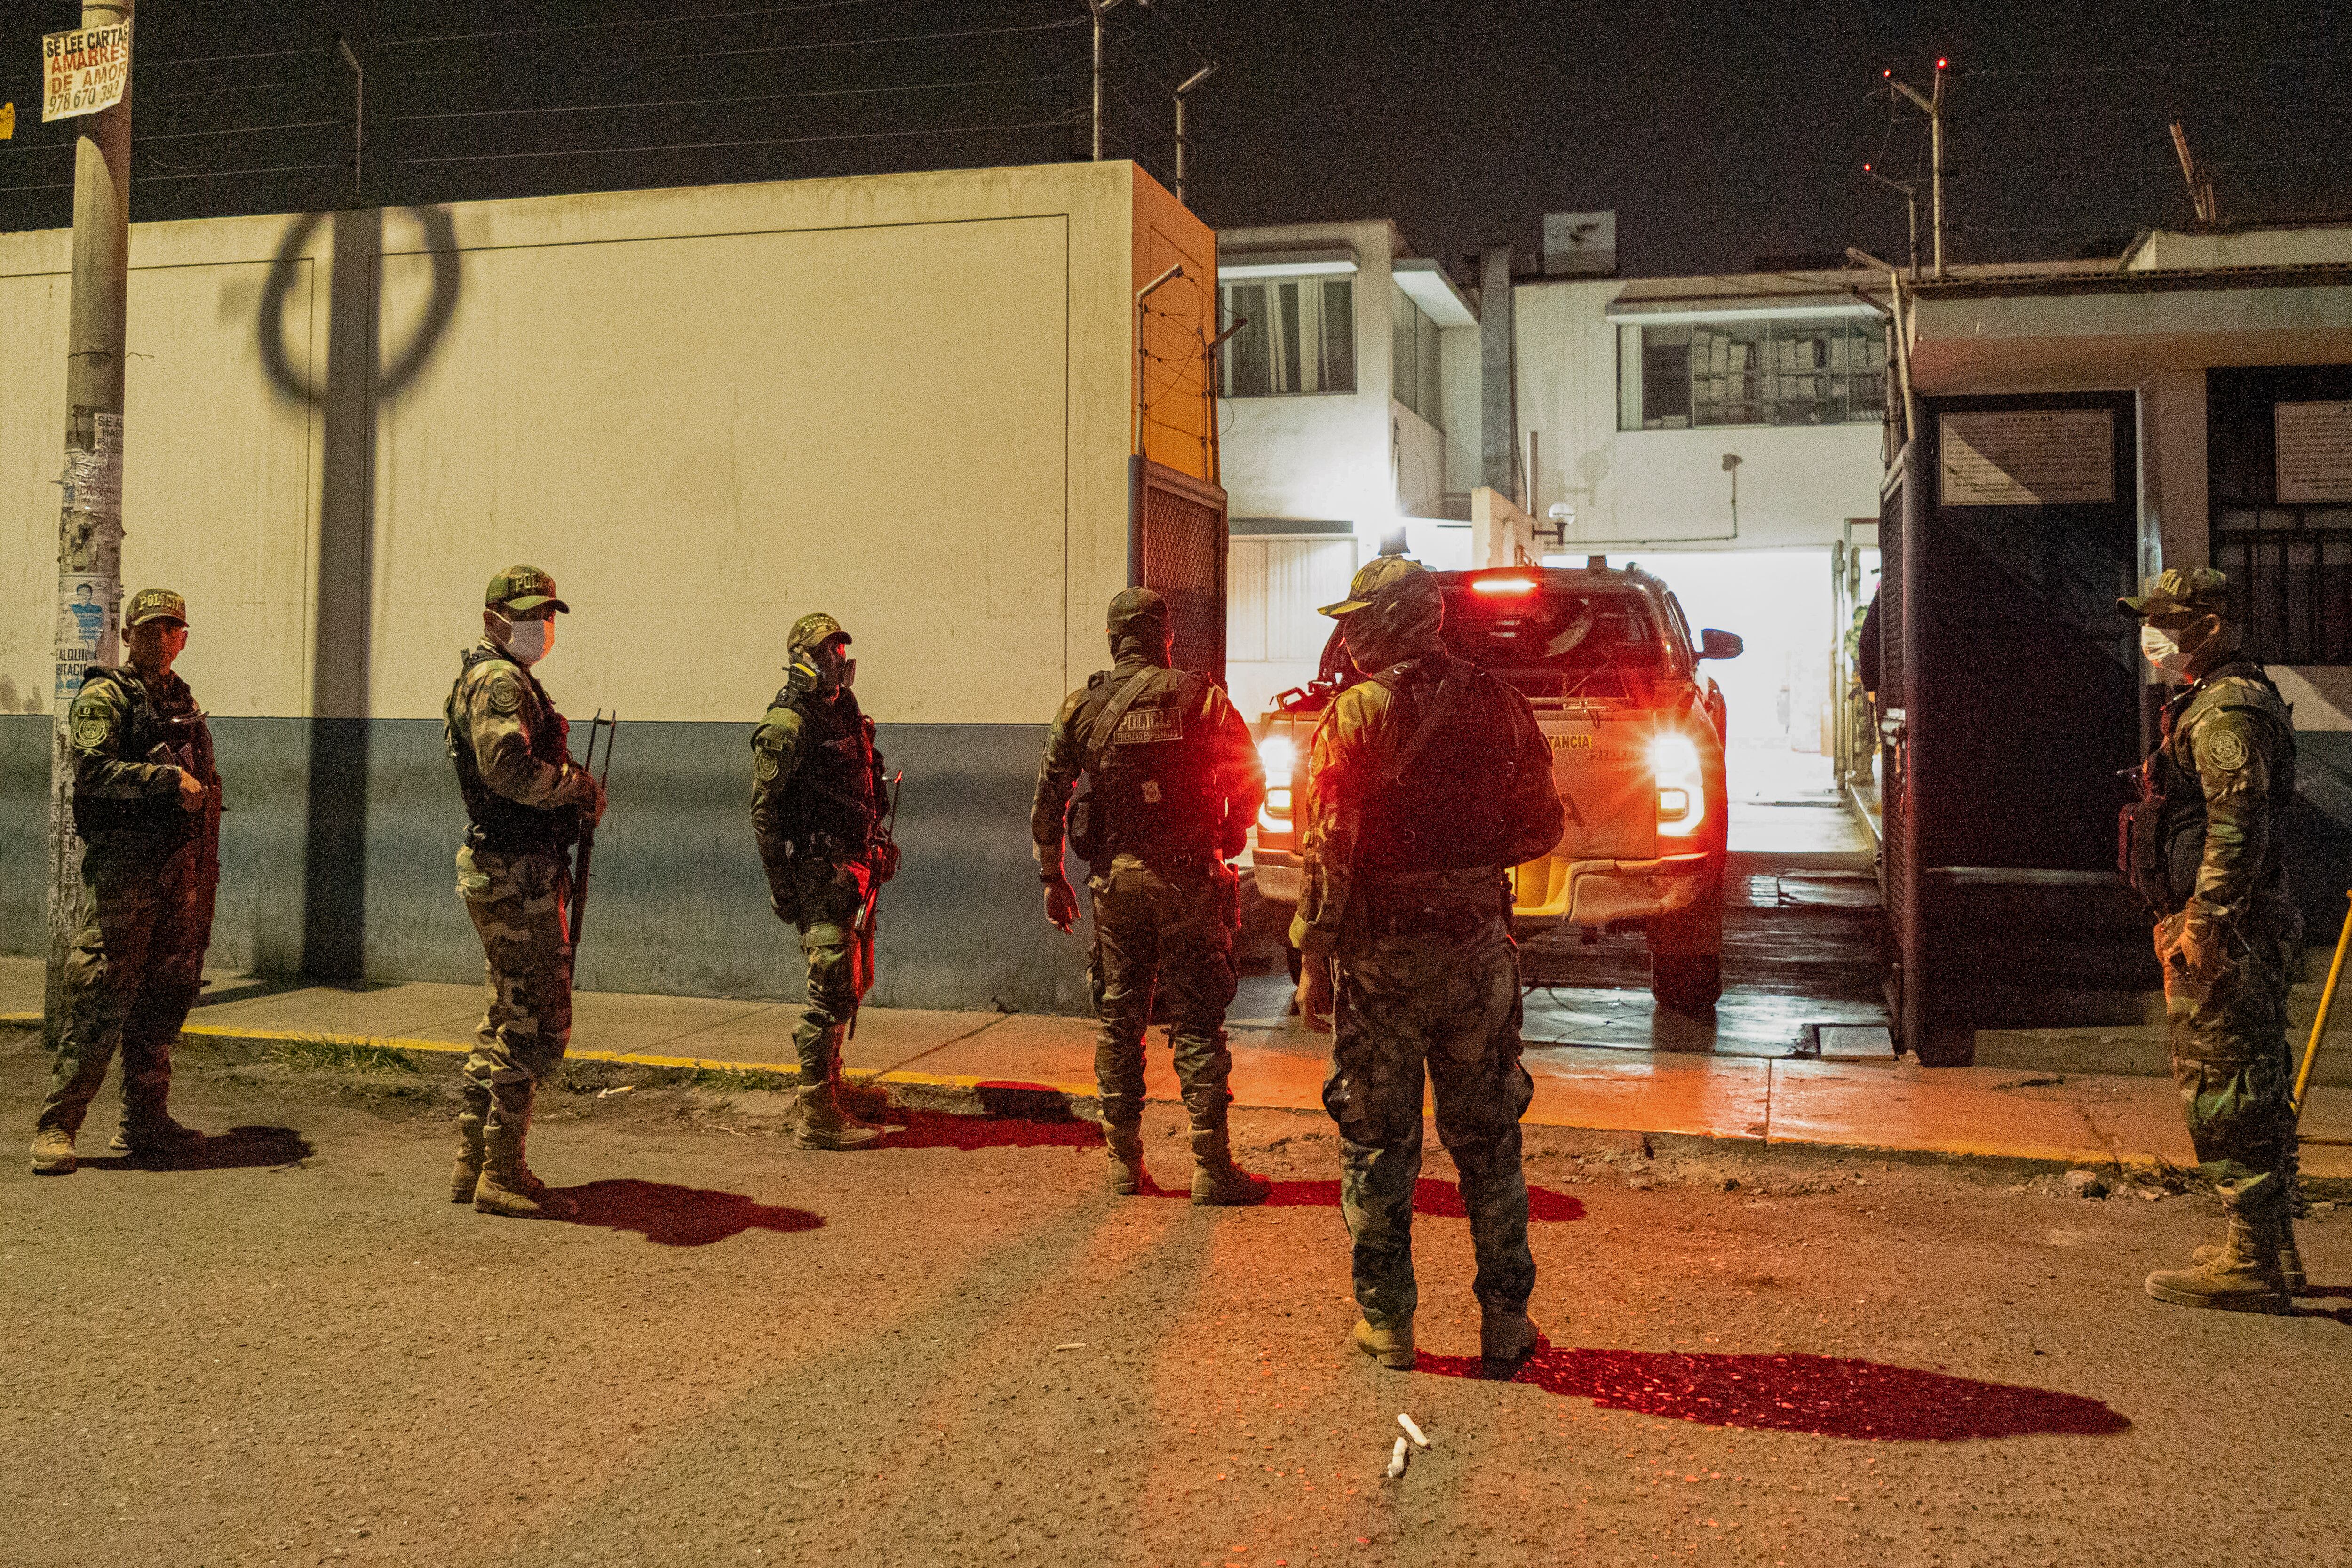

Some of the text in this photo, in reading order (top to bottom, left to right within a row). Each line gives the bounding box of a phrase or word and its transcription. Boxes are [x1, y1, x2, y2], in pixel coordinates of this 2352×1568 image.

[46, 25, 128, 58] SE LEE CARTAS
[51, 42, 127, 75] AMARRES
[52, 61, 126, 94] DE AMOR
[49, 92, 71, 114] 978
[74, 88, 95, 108] 670
